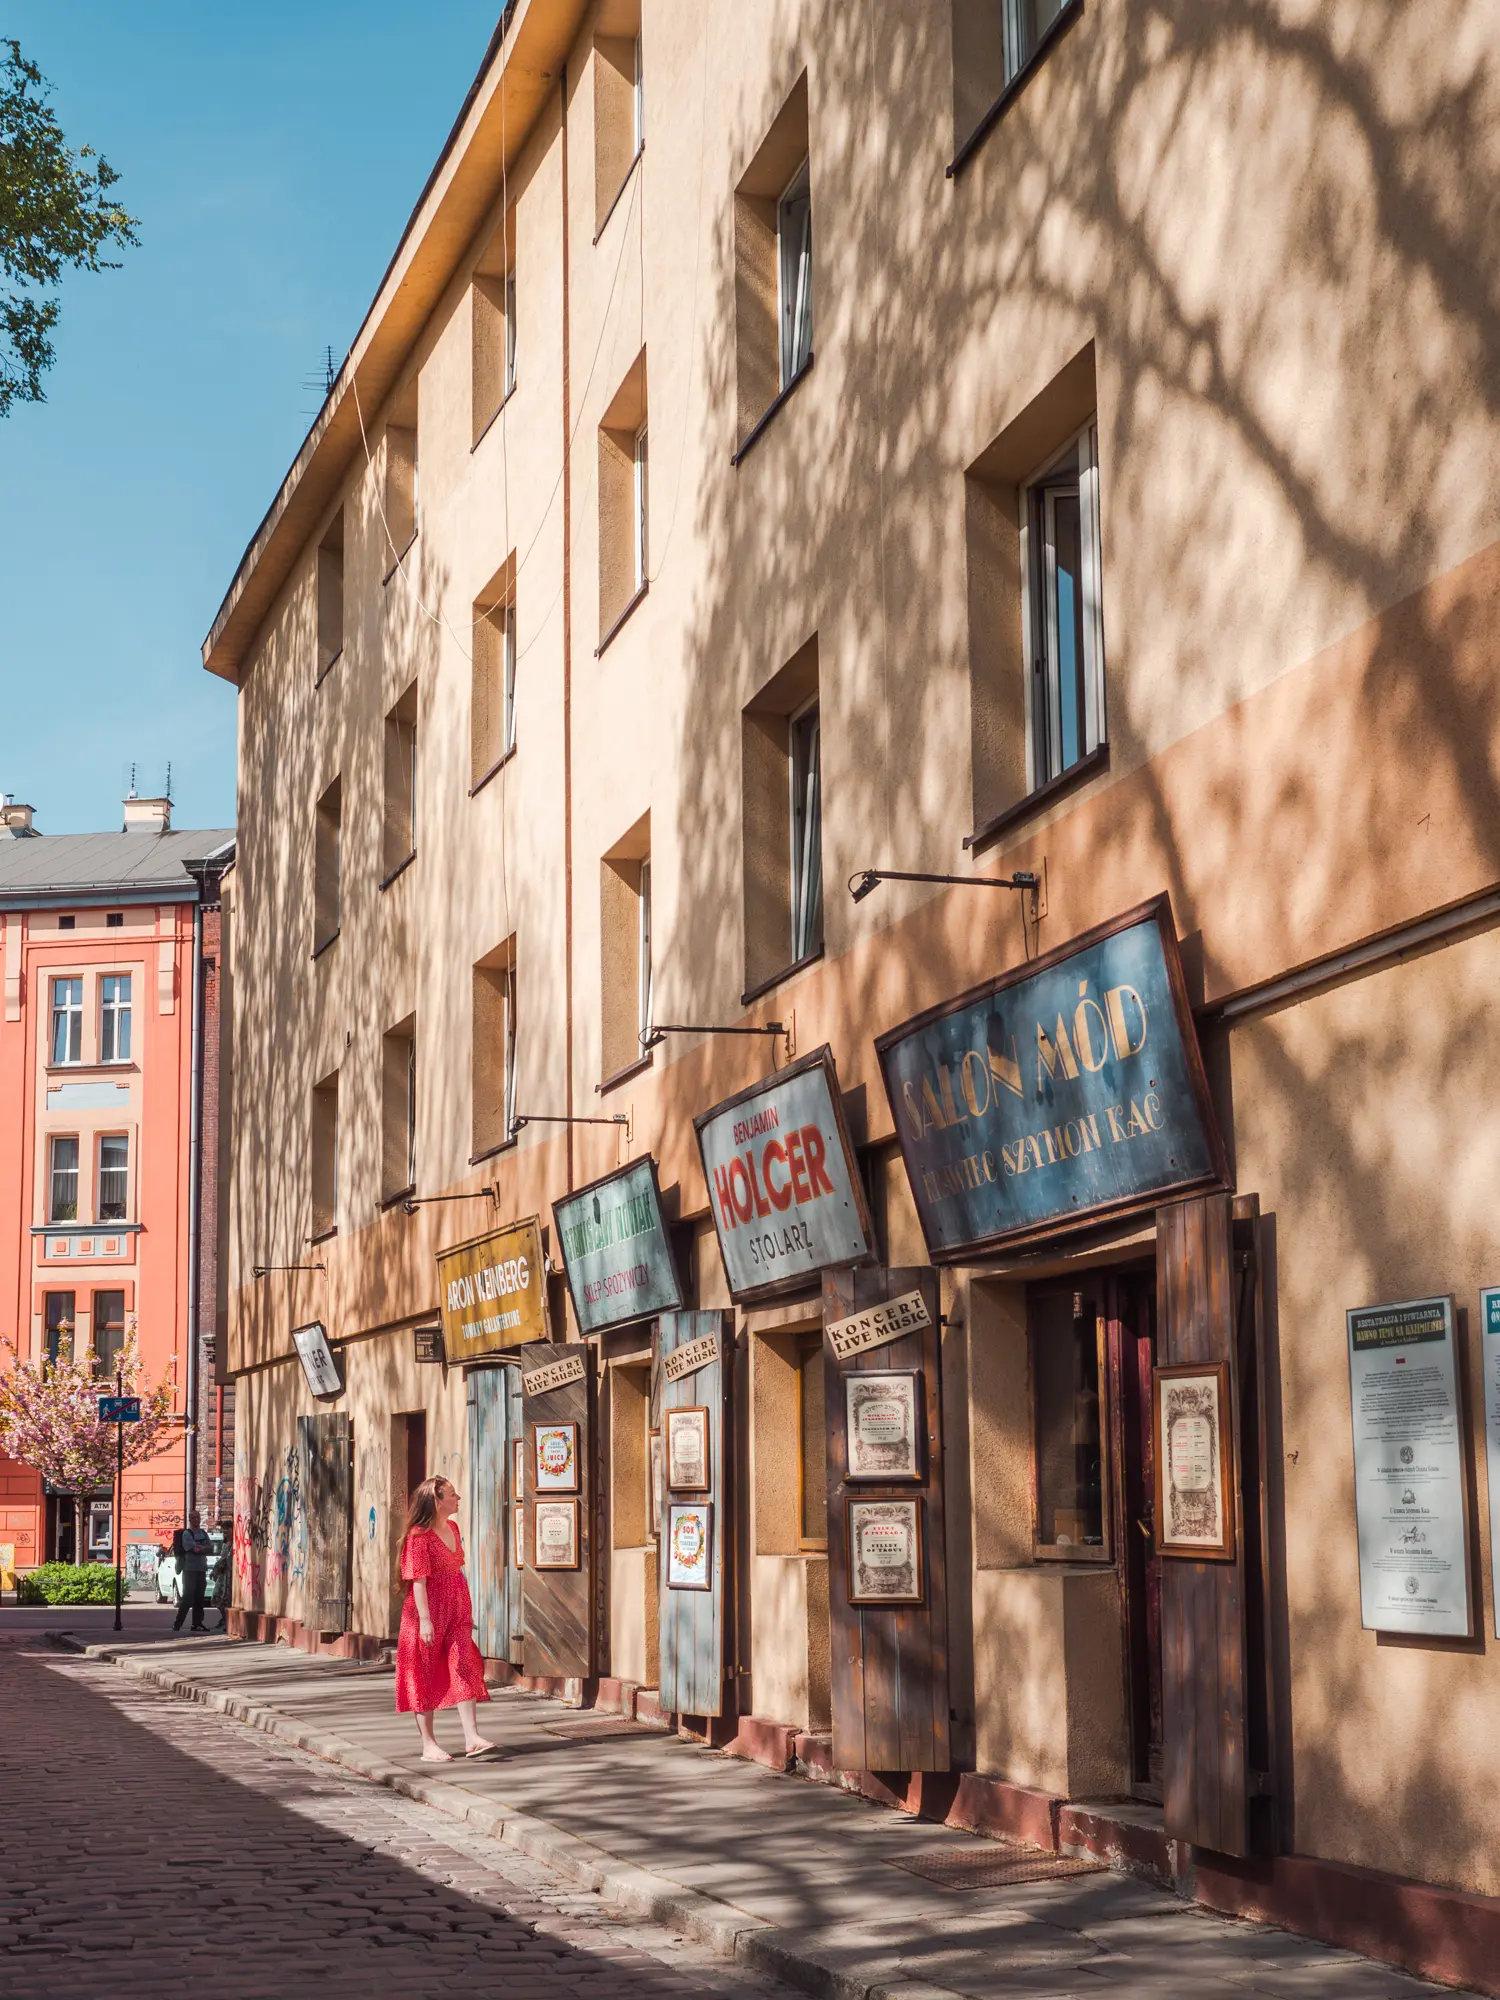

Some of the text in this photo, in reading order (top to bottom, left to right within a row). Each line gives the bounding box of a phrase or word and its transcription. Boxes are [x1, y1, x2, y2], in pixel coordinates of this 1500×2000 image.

[904, 979, 1148, 1142] SALON MÓD
[733, 1106, 780, 1146] BENJAMIN
[1001, 1113, 1102, 1177] SZYMON
[1104, 1091, 1166, 1144] KAC
[713, 1123, 837, 1233] HOLCER
[615, 1191, 657, 1244] NOWAK
[750, 1221, 814, 1264] STOLARZ
[447, 1255, 530, 1312] ARON WEINBERG
[583, 1263, 649, 1305] SKLEP SPOŻYWCZY
[461, 1320, 484, 1340] TOWARY
[831, 1297, 921, 1342] KONCERT
[835, 1310, 928, 1354] LIVE MUSIC
[1356, 1328, 1378, 1342] DAWNO
[1378, 1325, 1395, 1339] TEMU
[1395, 1324, 1404, 1336] NA
[1357, 1315, 1399, 1328] RESTAURACJA
[1403, 1309, 1441, 1322] PIWIARNIA
[526, 1359, 580, 1385] KONCERT
[664, 1338, 715, 1370] KONCERT
[667, 1347, 717, 1378] LIVE MUSIC
[528, 1367, 583, 1393] LIVE MUSIC
[682, 1525, 695, 1534] SOK
